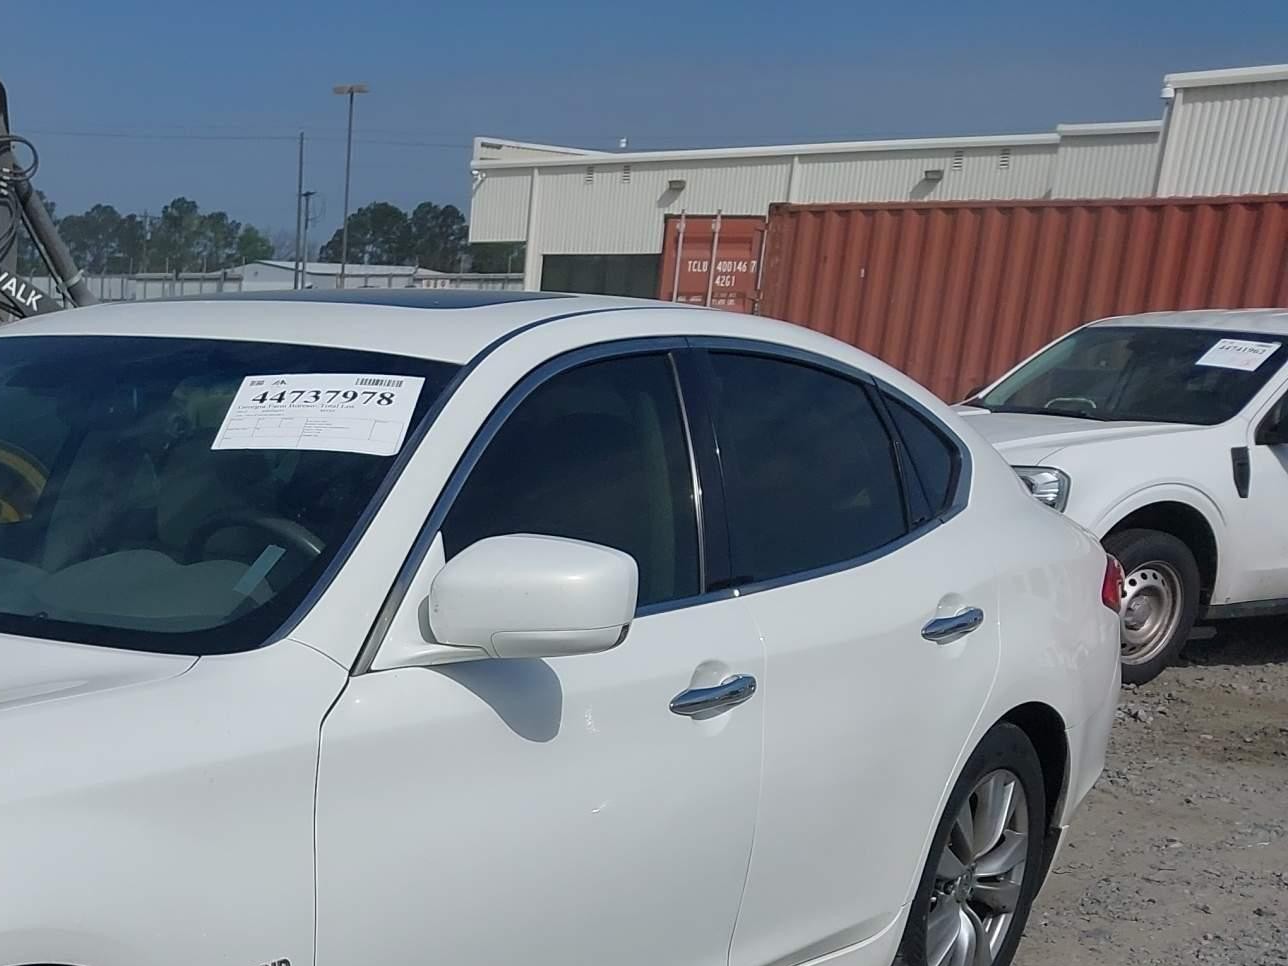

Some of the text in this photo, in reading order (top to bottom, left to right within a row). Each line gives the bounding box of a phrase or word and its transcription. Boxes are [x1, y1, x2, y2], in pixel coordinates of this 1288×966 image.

[688, 261, 708, 273] TCLU
[716, 261, 747, 273] 400146
[714, 275, 736, 287] 42G1
[251, 390, 395, 406] 44737978
